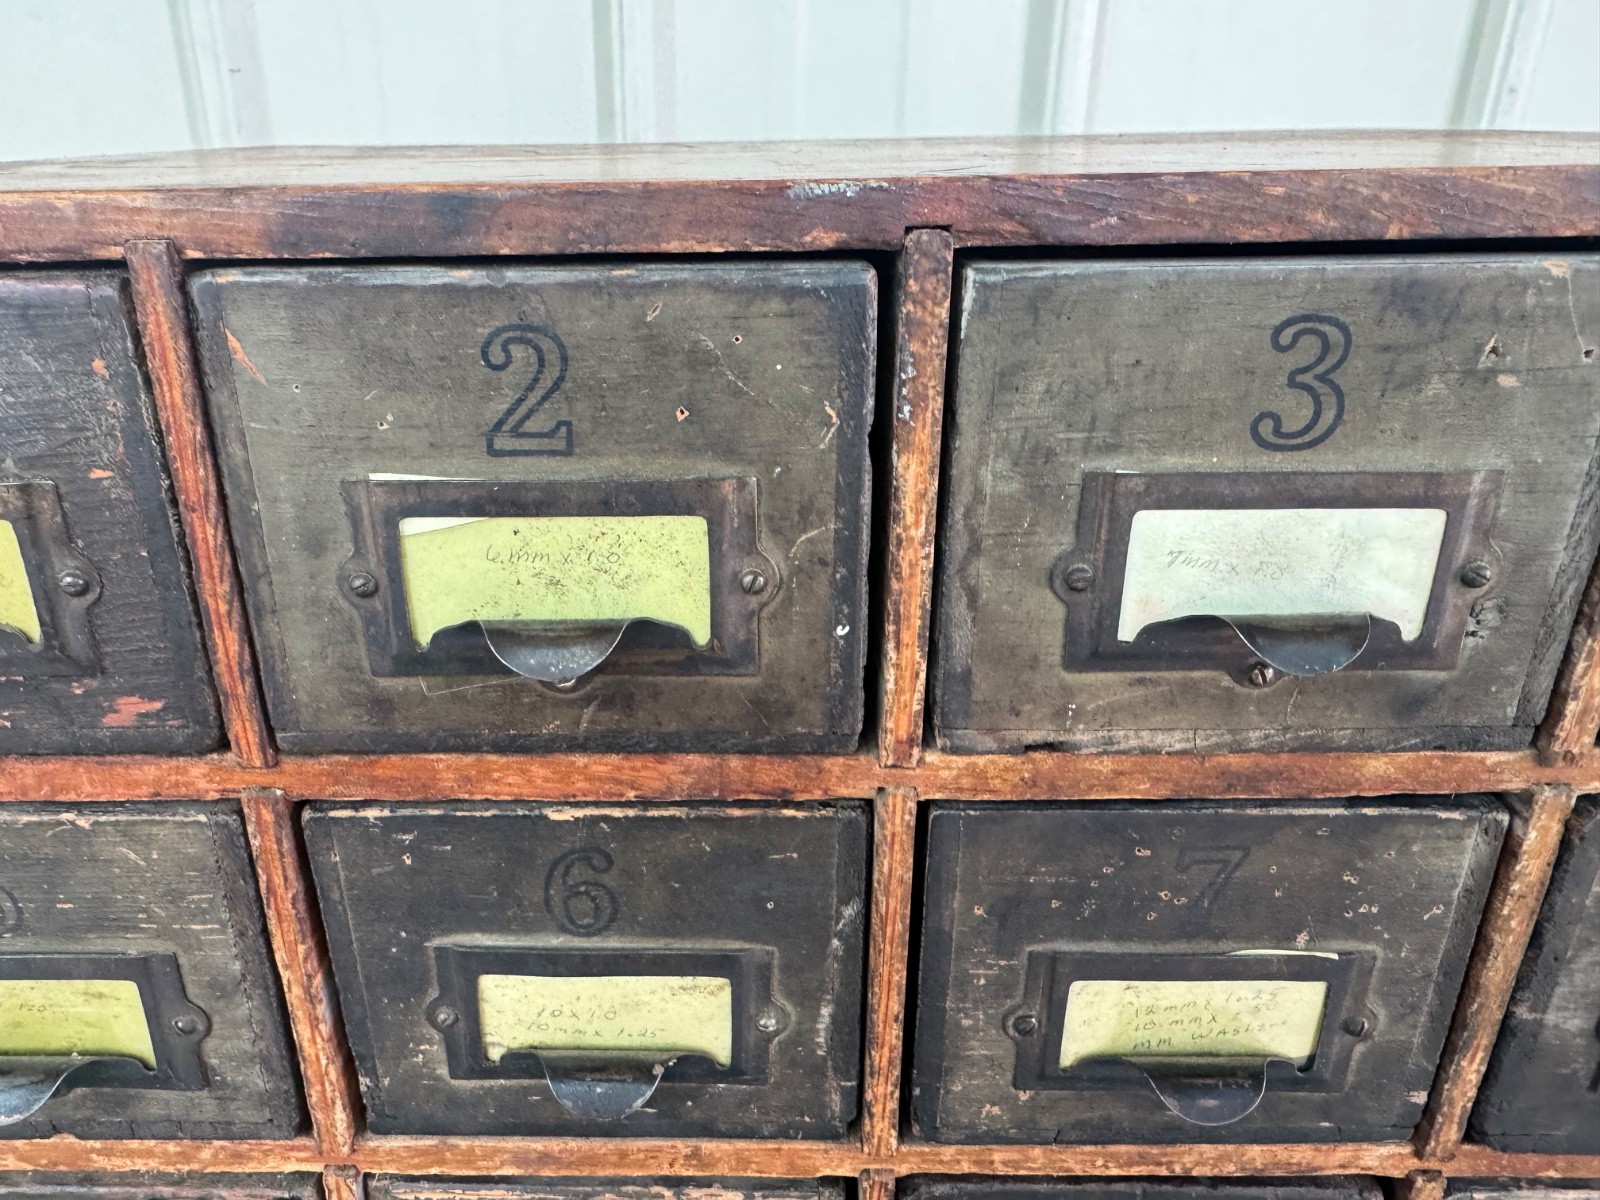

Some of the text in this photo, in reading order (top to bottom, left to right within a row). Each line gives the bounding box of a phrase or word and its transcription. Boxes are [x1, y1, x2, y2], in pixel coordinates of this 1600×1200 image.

[481, 323, 574, 457] 2
[1250, 313, 1352, 452] 3
[543, 846, 619, 937] 6
[1174, 845, 1251, 917] 7
